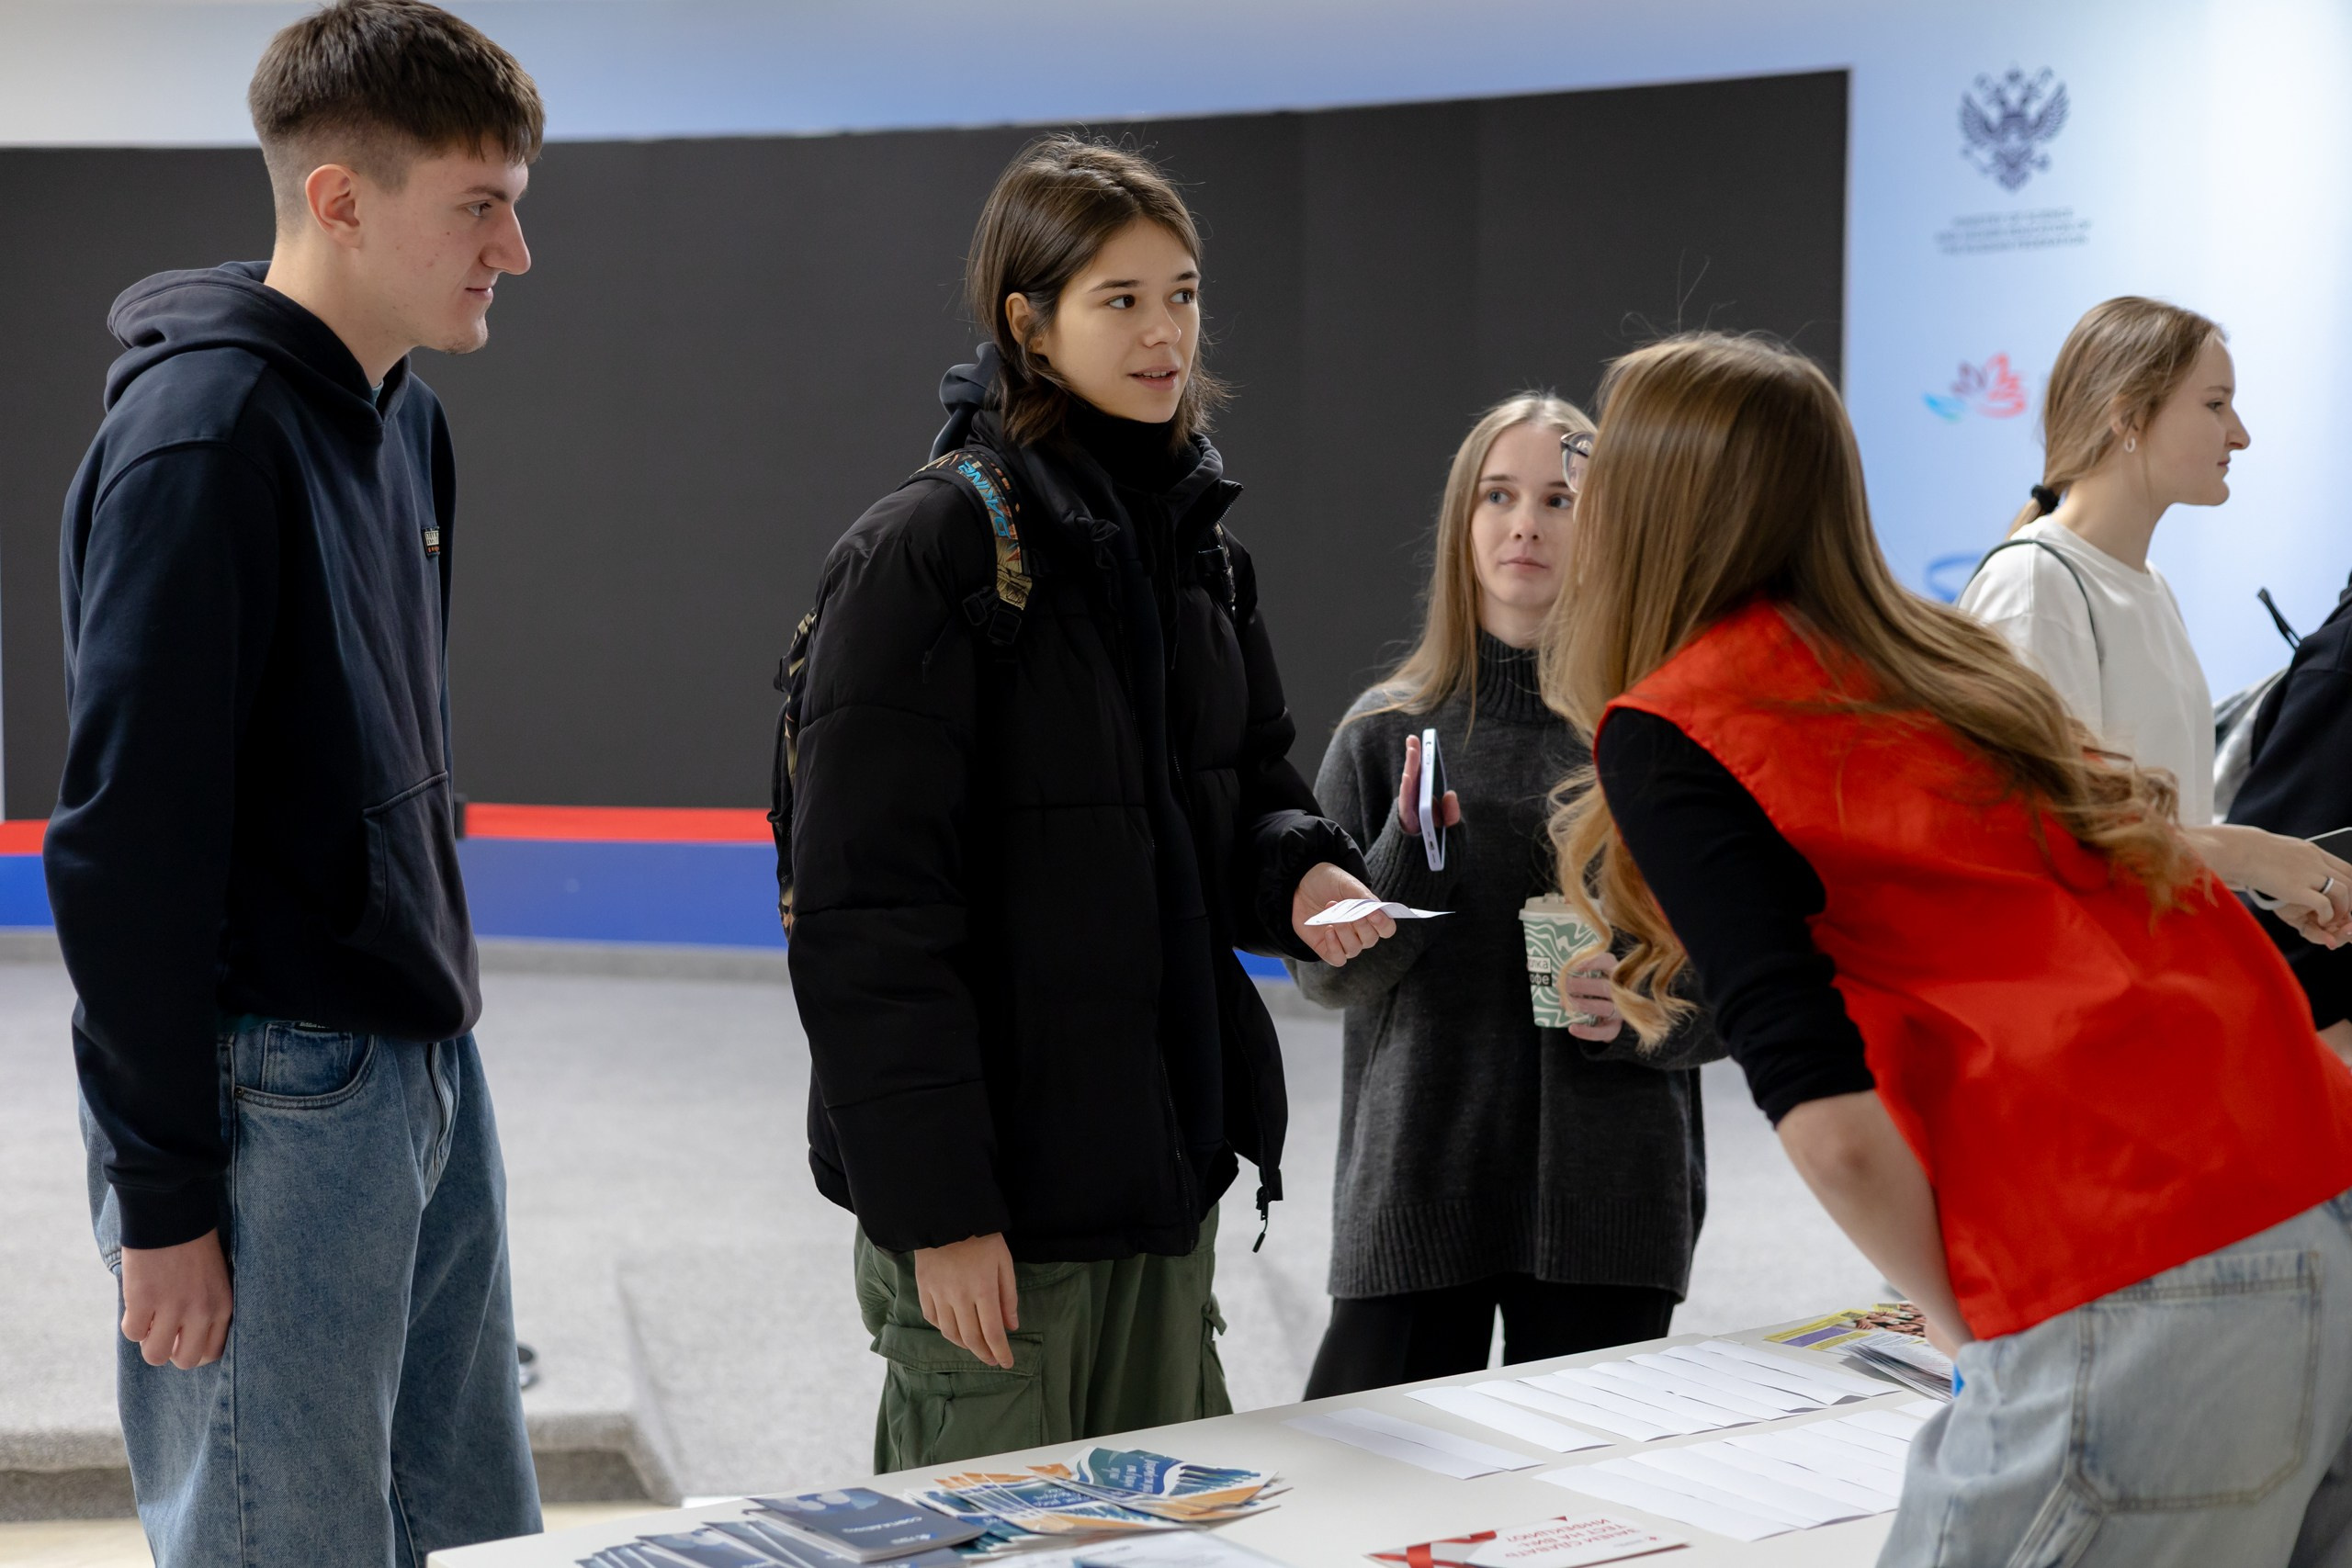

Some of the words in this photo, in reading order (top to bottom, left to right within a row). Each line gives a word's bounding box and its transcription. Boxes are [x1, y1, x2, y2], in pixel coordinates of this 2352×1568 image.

[958, 460, 1011, 539] DAKINE
[1530, 973, 1550, 985] офе
[1558, 1531, 1585, 1540] НА
[1585, 1528, 1641, 1543] ЗАЧЕМ
[1587, 1523, 1626, 1535] ТЕСТ
[1505, 1540, 1582, 1558] СДАВАТЬ
